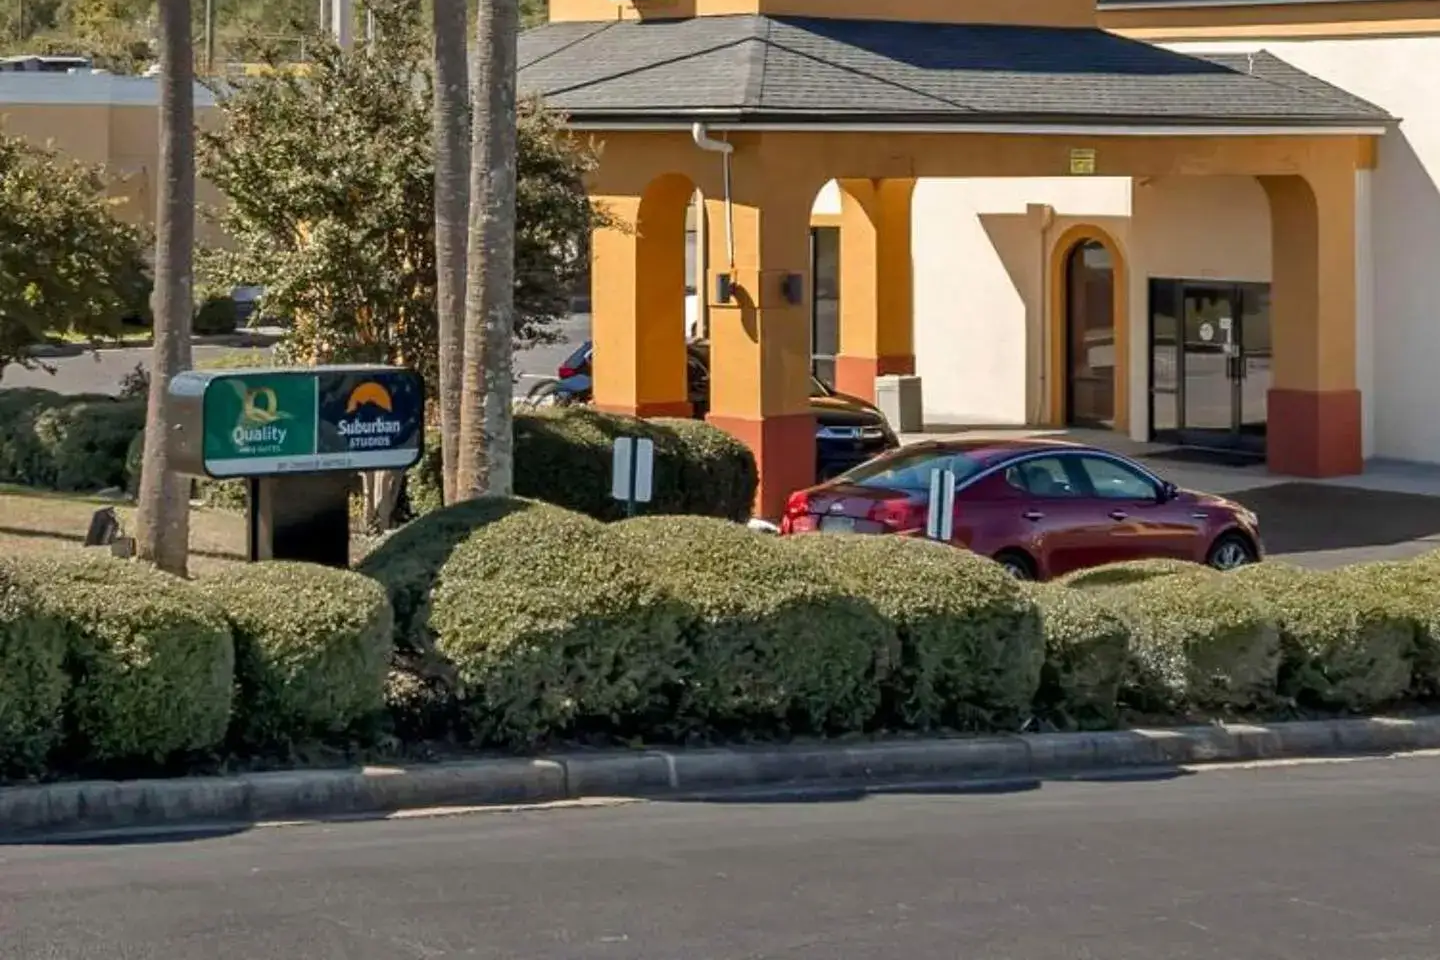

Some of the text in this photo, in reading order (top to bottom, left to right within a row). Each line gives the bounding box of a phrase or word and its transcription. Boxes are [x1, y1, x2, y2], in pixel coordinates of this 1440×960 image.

[244, 387, 279, 423] Q
[337, 416, 400, 434] Suburban
[232, 426, 287, 446] Quality
[350, 436, 391, 448] STUDIOS
